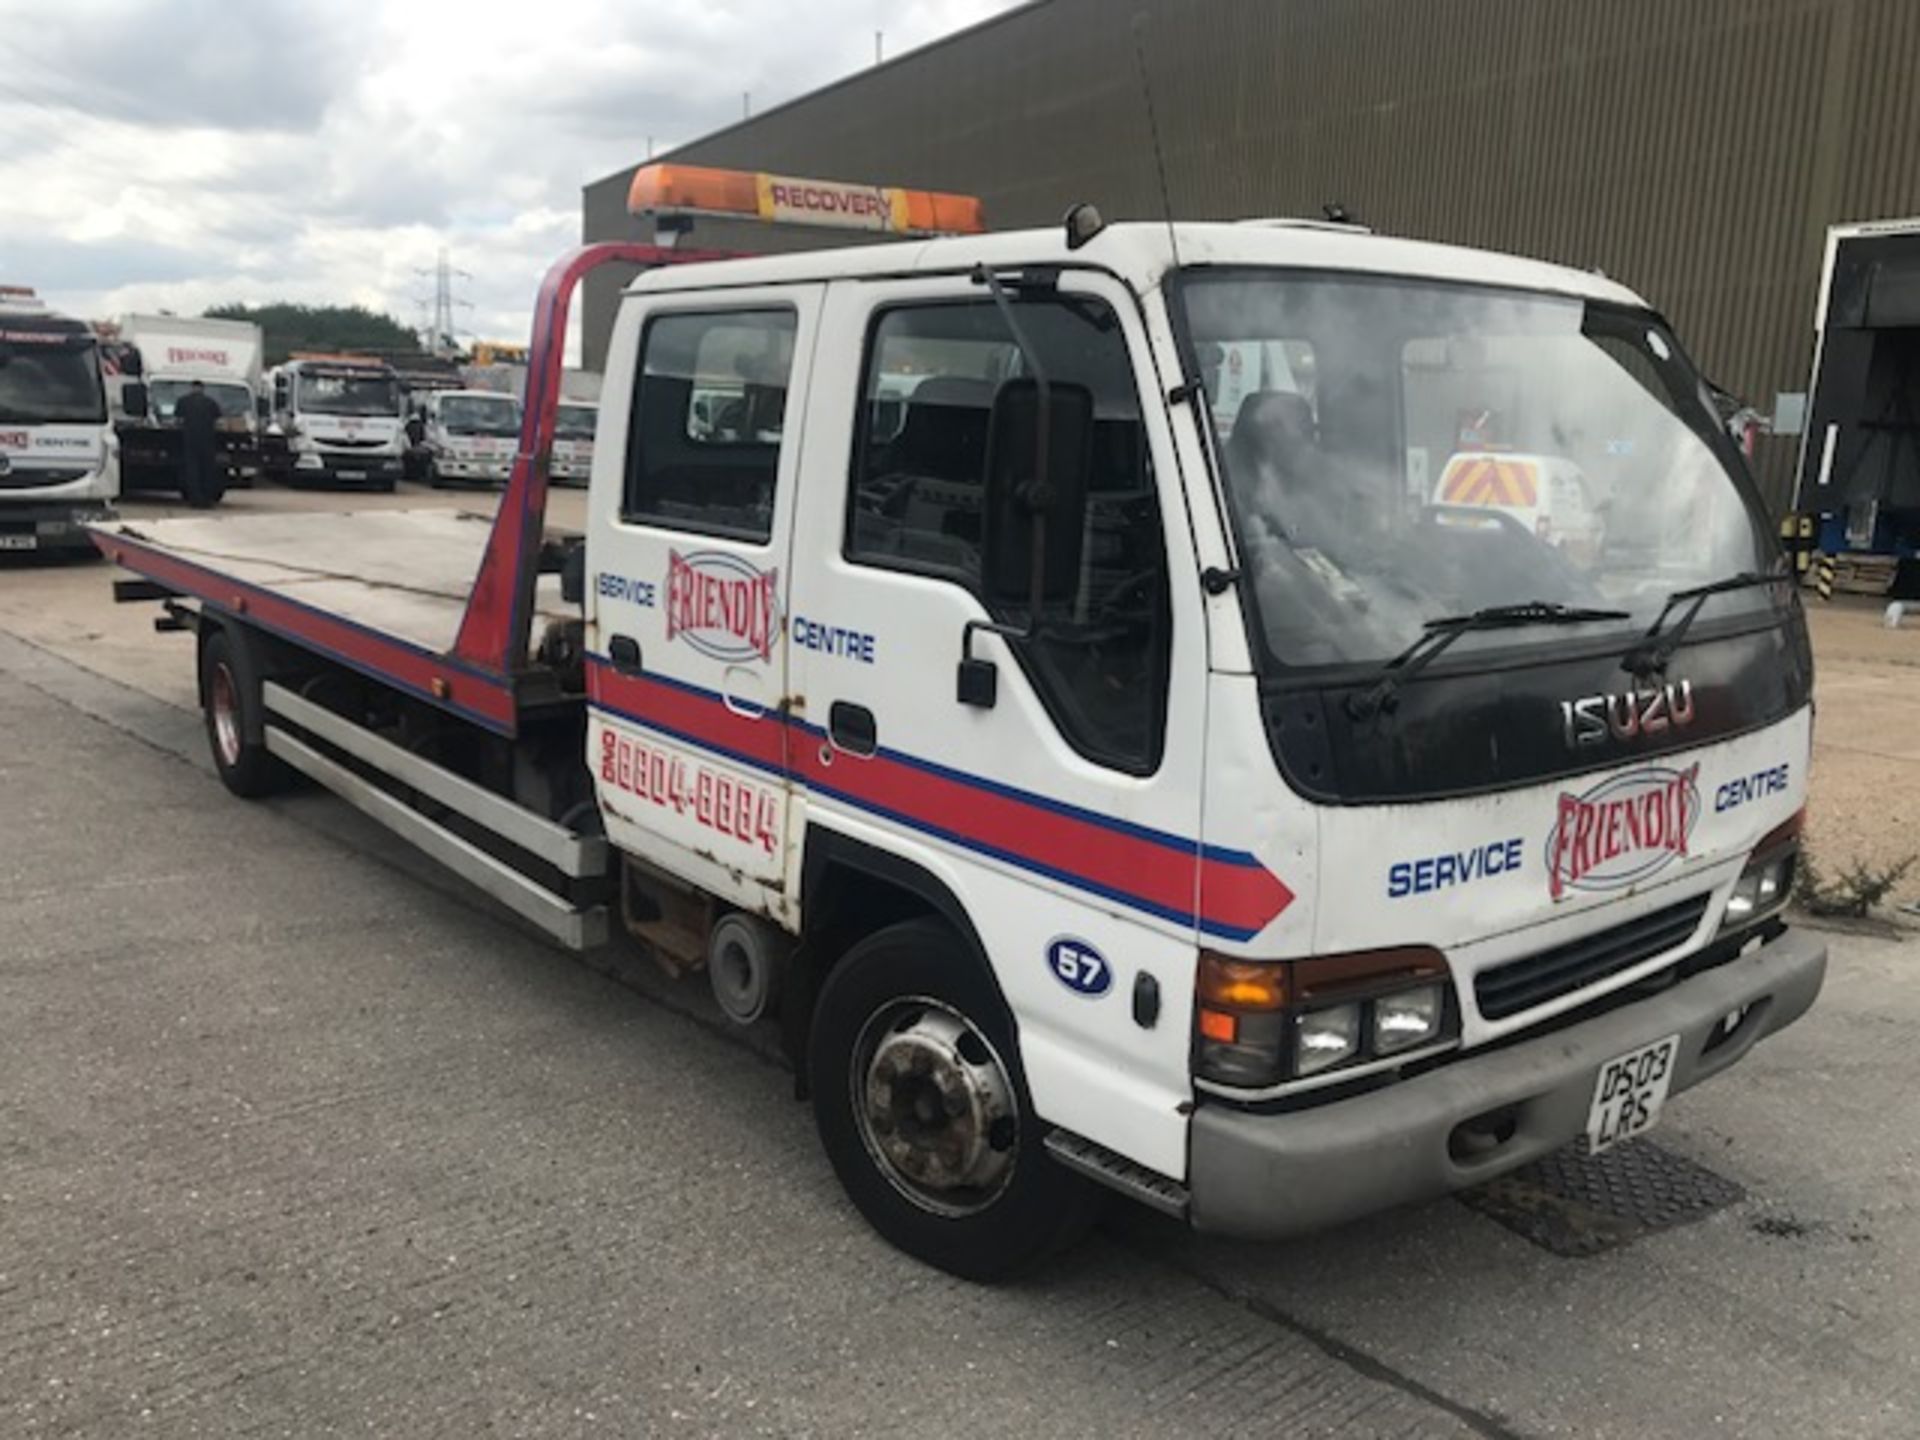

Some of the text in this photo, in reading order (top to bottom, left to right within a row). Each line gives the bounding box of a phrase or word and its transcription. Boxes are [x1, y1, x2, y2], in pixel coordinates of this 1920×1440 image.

[771, 184, 892, 217] RECOVERY
[599, 548, 876, 664] SERVICE FRIENDLY CENTRE
[1561, 679, 1694, 748] ISUZU
[1388, 761, 1790, 901] SERVICE FRIENDLY CENTRE
[1058, 944, 1102, 986] 57
[1599, 1042, 1672, 1105] DS03
[1598, 1091, 1652, 1145] LRS
